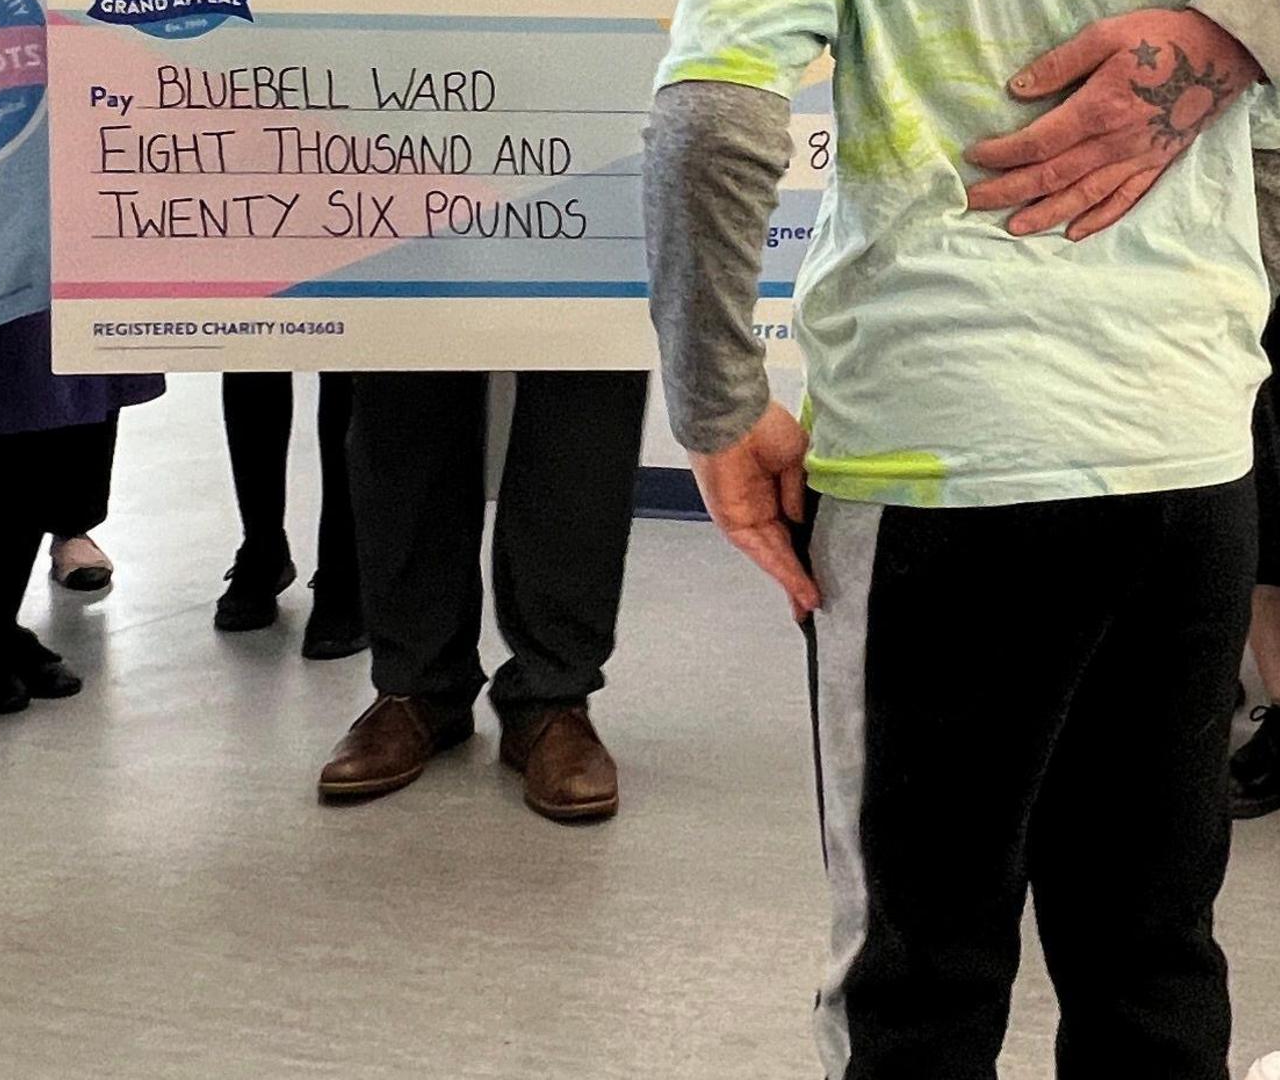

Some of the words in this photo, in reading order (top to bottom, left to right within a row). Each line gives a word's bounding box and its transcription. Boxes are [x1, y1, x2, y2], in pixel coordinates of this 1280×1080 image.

[90, 86, 134, 115] Pay
[157, 65, 350, 111] BLUEBELL
[372, 67, 496, 112] WARD
[99, 125, 236, 174] EIGHT
[263, 126, 473, 176] THOUSAND
[492, 134, 572, 176] AND
[99, 190, 300, 239] TWENTY
[322, 189, 399, 239] SIX
[425, 190, 587, 239] POUNDS
[93, 322, 198, 336] REGISTERED
[202, 322, 275, 335] CHARITY
